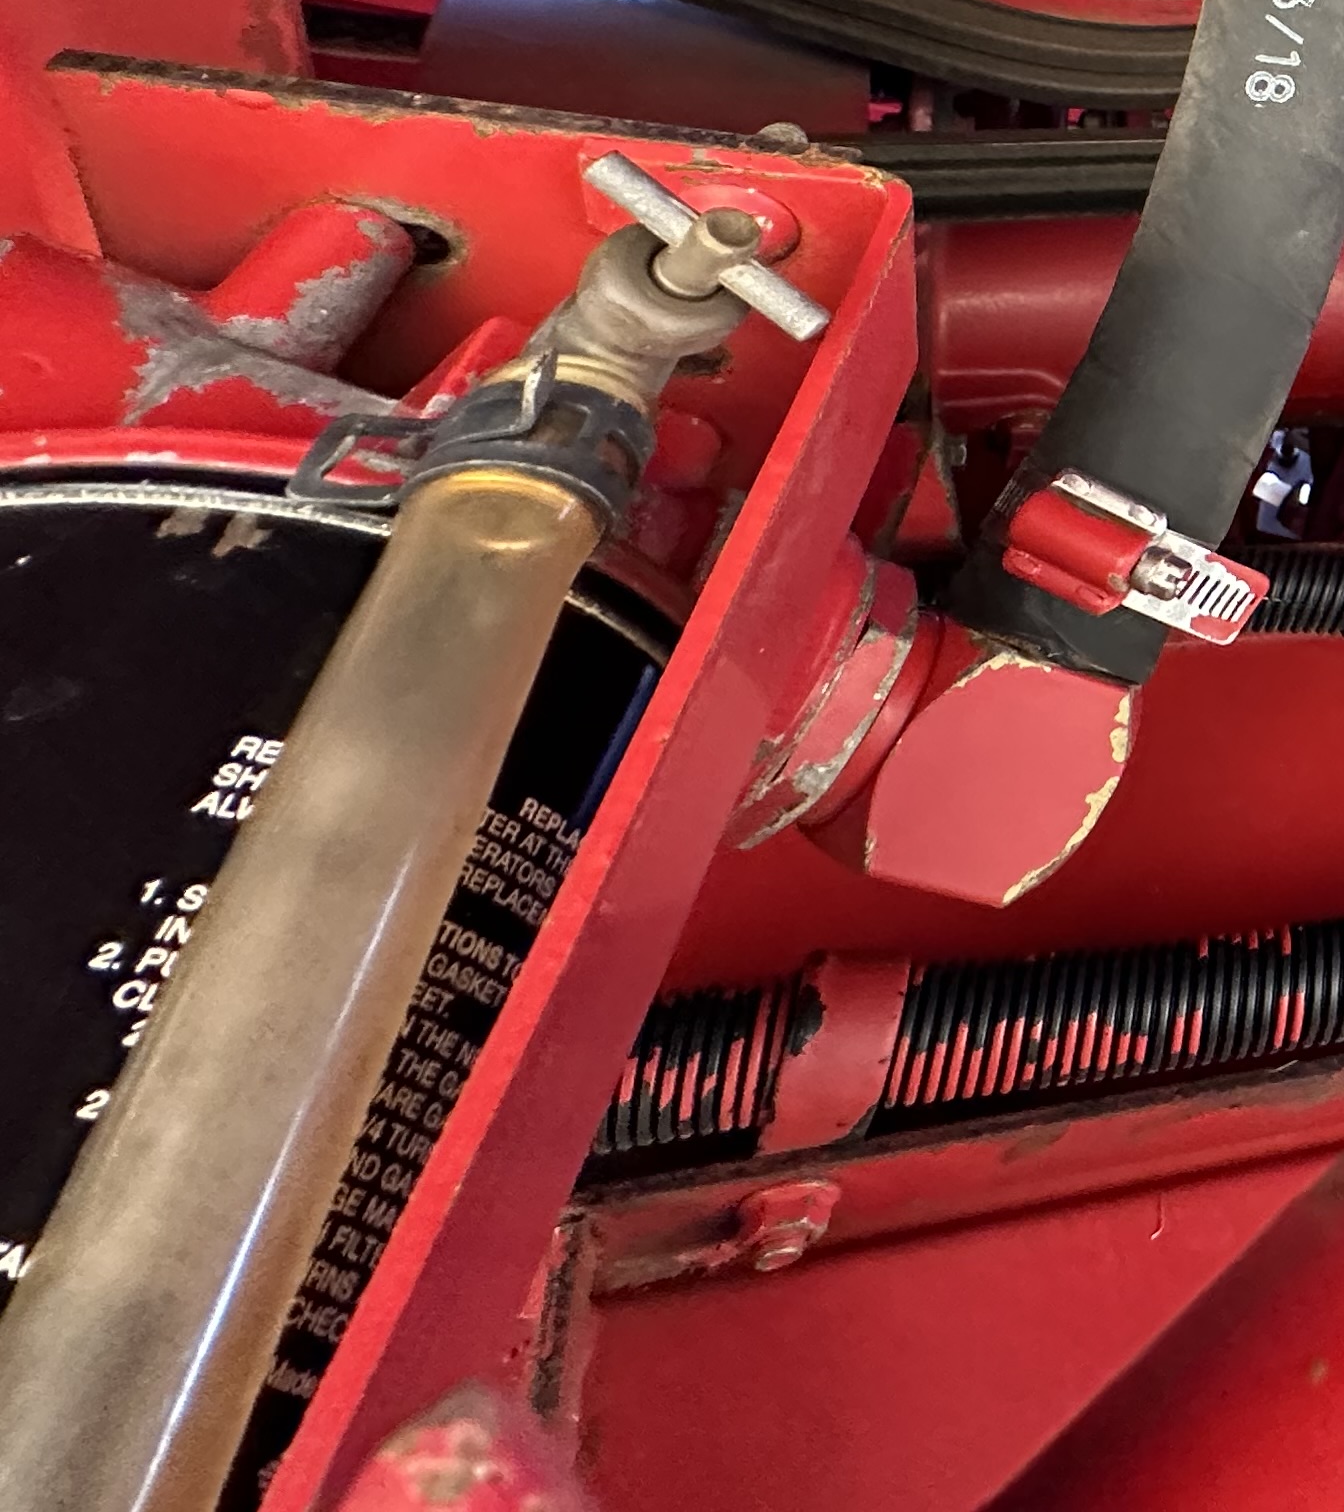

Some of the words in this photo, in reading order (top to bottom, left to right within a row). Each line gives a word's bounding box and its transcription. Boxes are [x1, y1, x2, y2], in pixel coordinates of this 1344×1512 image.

[231, 735, 284, 765] RE
[212, 762, 269, 791] SH
[518, 832, 548, 858] AT
[140, 879, 163, 905] 1.
[88, 941, 123, 970] 2.
[427, 952, 508, 1008] GASKET
[417, 1019, 461, 1060] THE
[396, 1048, 442, 1089] THE
